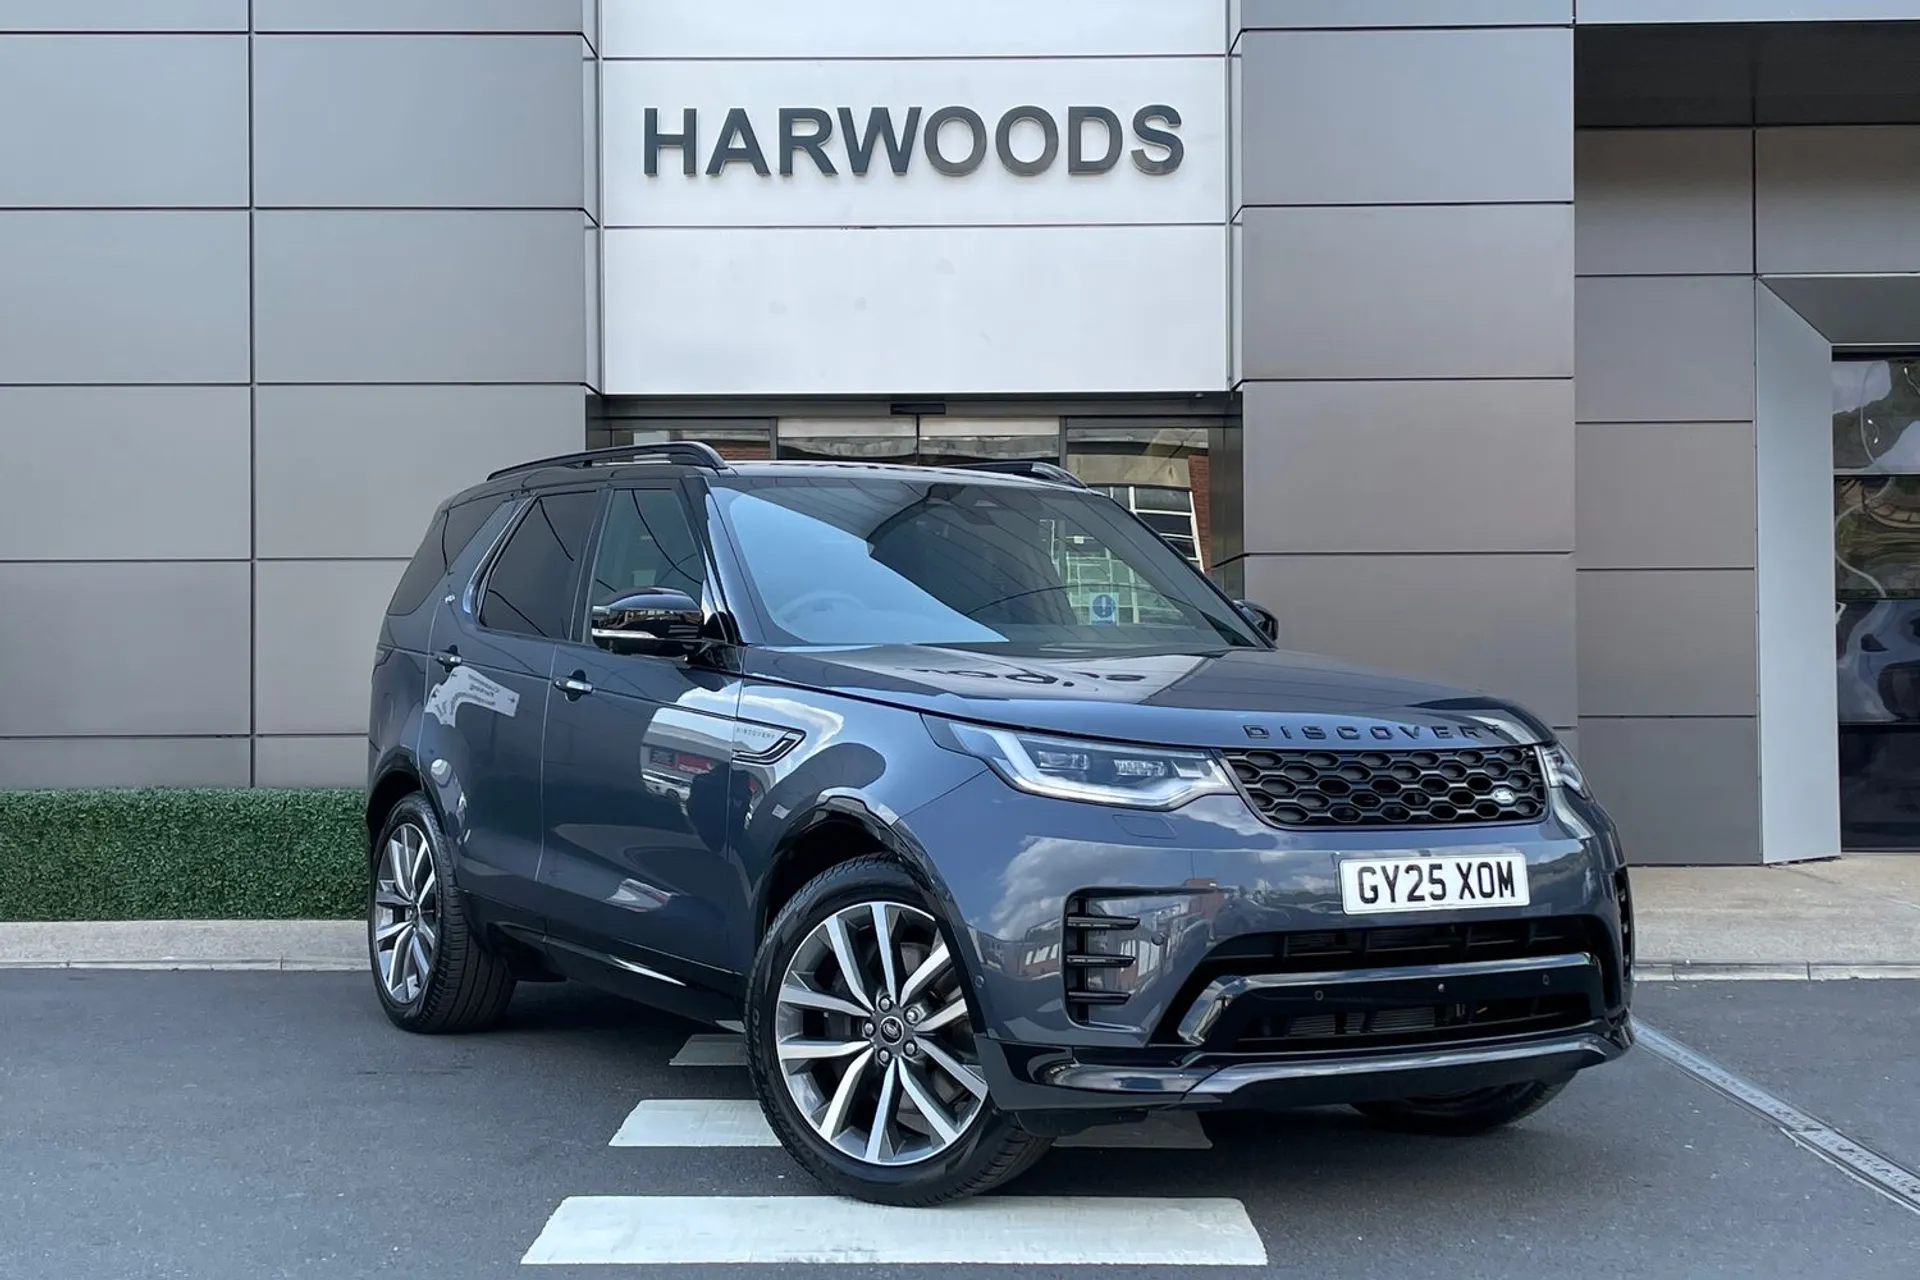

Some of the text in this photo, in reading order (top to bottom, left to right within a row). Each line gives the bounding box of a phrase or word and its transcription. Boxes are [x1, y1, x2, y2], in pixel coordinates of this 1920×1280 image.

[643, 105, 1185, 177] HARWOODS
[1243, 723, 1500, 740] DISCOVERY
[1357, 860, 1516, 904] GY25 XOM
